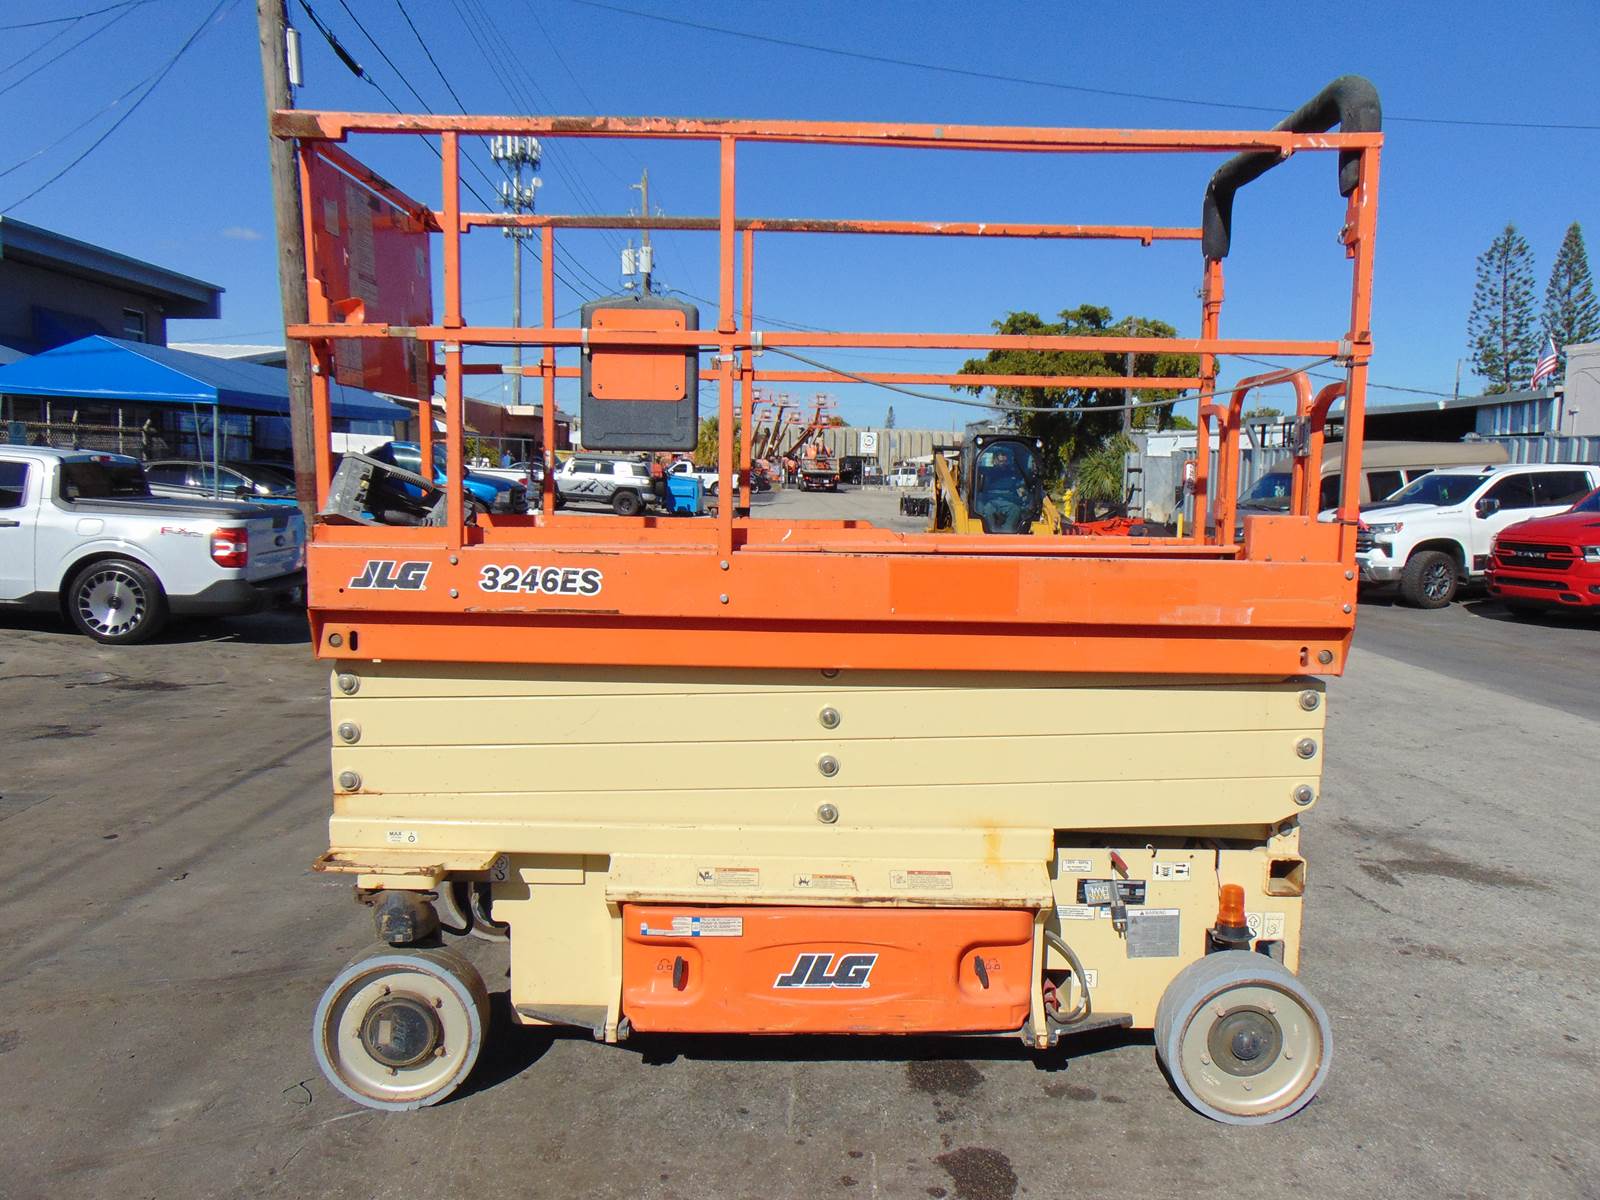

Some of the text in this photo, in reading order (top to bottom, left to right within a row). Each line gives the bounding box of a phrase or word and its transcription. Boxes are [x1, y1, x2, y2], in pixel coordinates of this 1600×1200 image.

[348, 560, 432, 590] JLG
[479, 564, 603, 596] 3246ES
[773, 953, 879, 988] JLG
